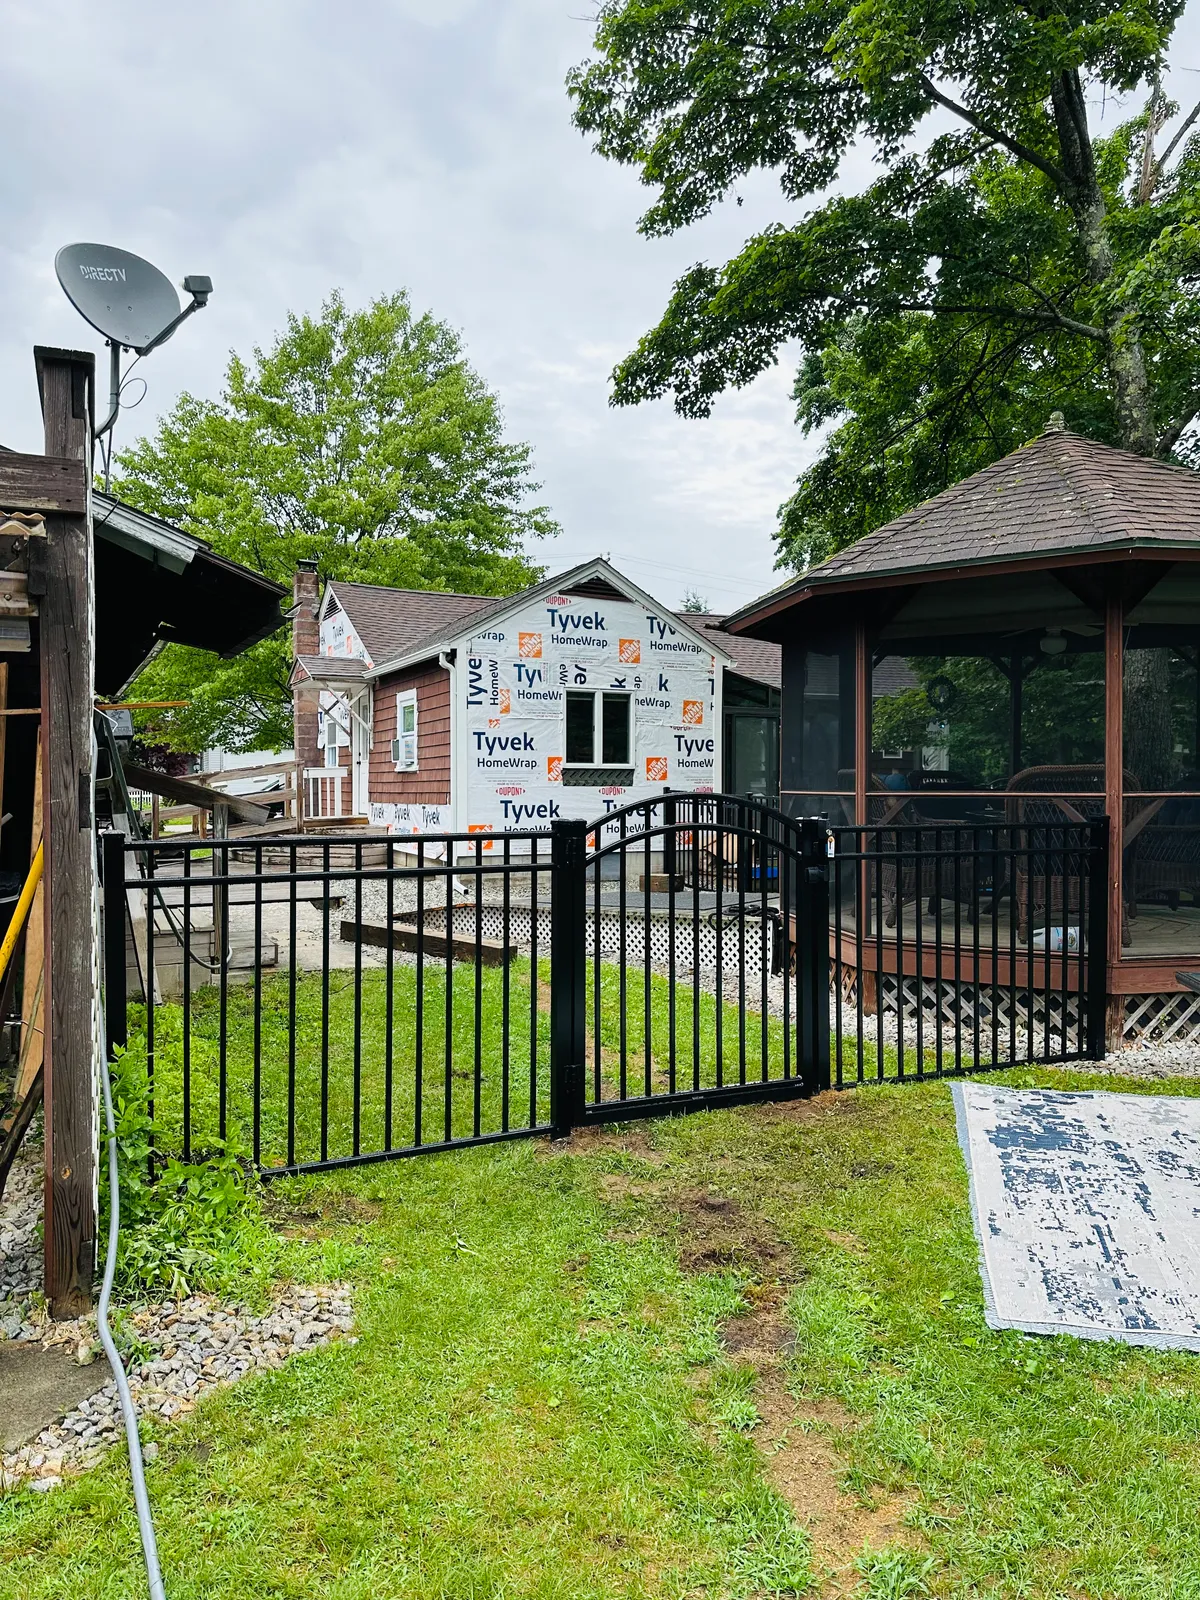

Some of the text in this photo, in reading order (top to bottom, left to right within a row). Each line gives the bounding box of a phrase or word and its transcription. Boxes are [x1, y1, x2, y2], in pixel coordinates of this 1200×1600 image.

[79, 265, 126, 282] DIRECTV
[547, 608, 606, 633] Tyvek
[551, 634, 608, 649] HomeWrap
[650, 640, 702, 654] HomeWrap
[473, 732, 535, 756] Tyvek
[477, 758, 537, 770] HomeWrap
[499, 787, 522, 796] DUPONT
[602, 787, 623, 796] DUPONT
[422, 806, 441, 828] Tyvek
[500, 800, 560, 823] Tyvek
